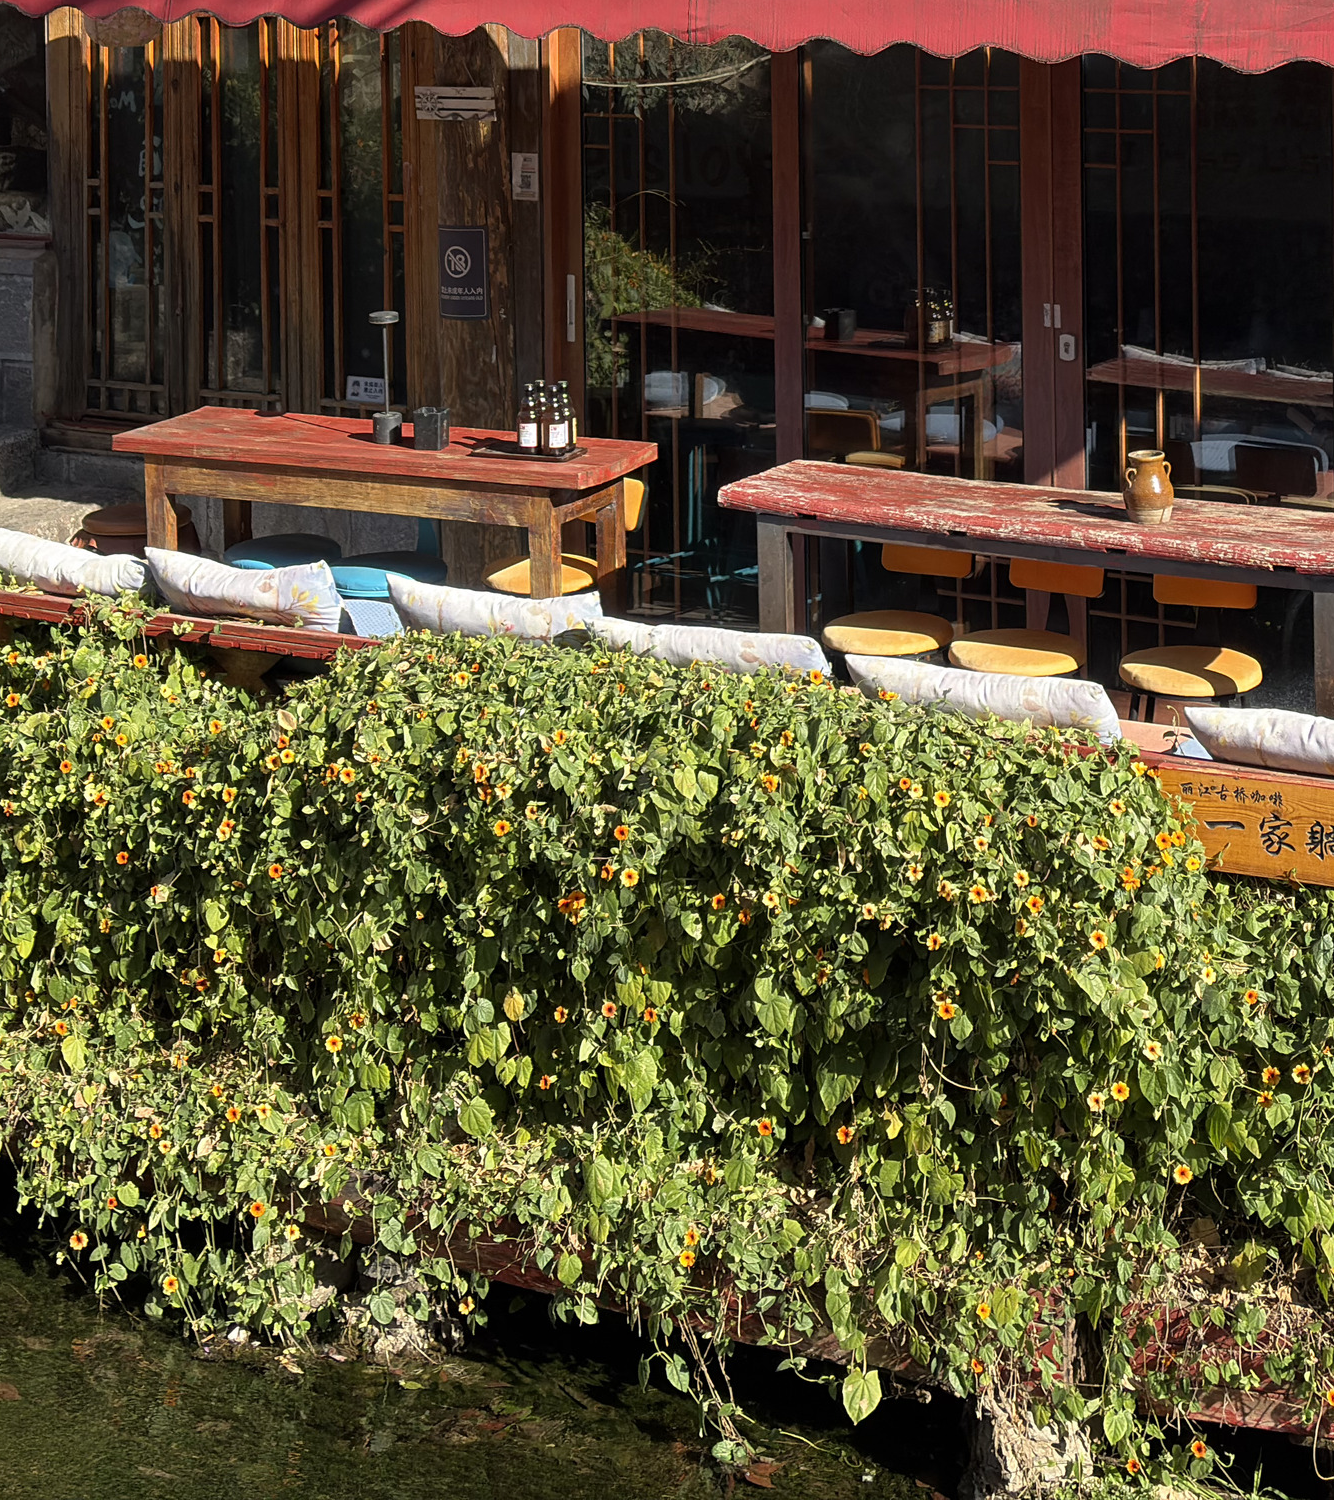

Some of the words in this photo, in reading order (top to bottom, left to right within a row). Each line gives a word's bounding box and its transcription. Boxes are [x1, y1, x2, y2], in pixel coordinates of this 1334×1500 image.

[1180, 781, 1285, 807] 丽江古桥咖啡
